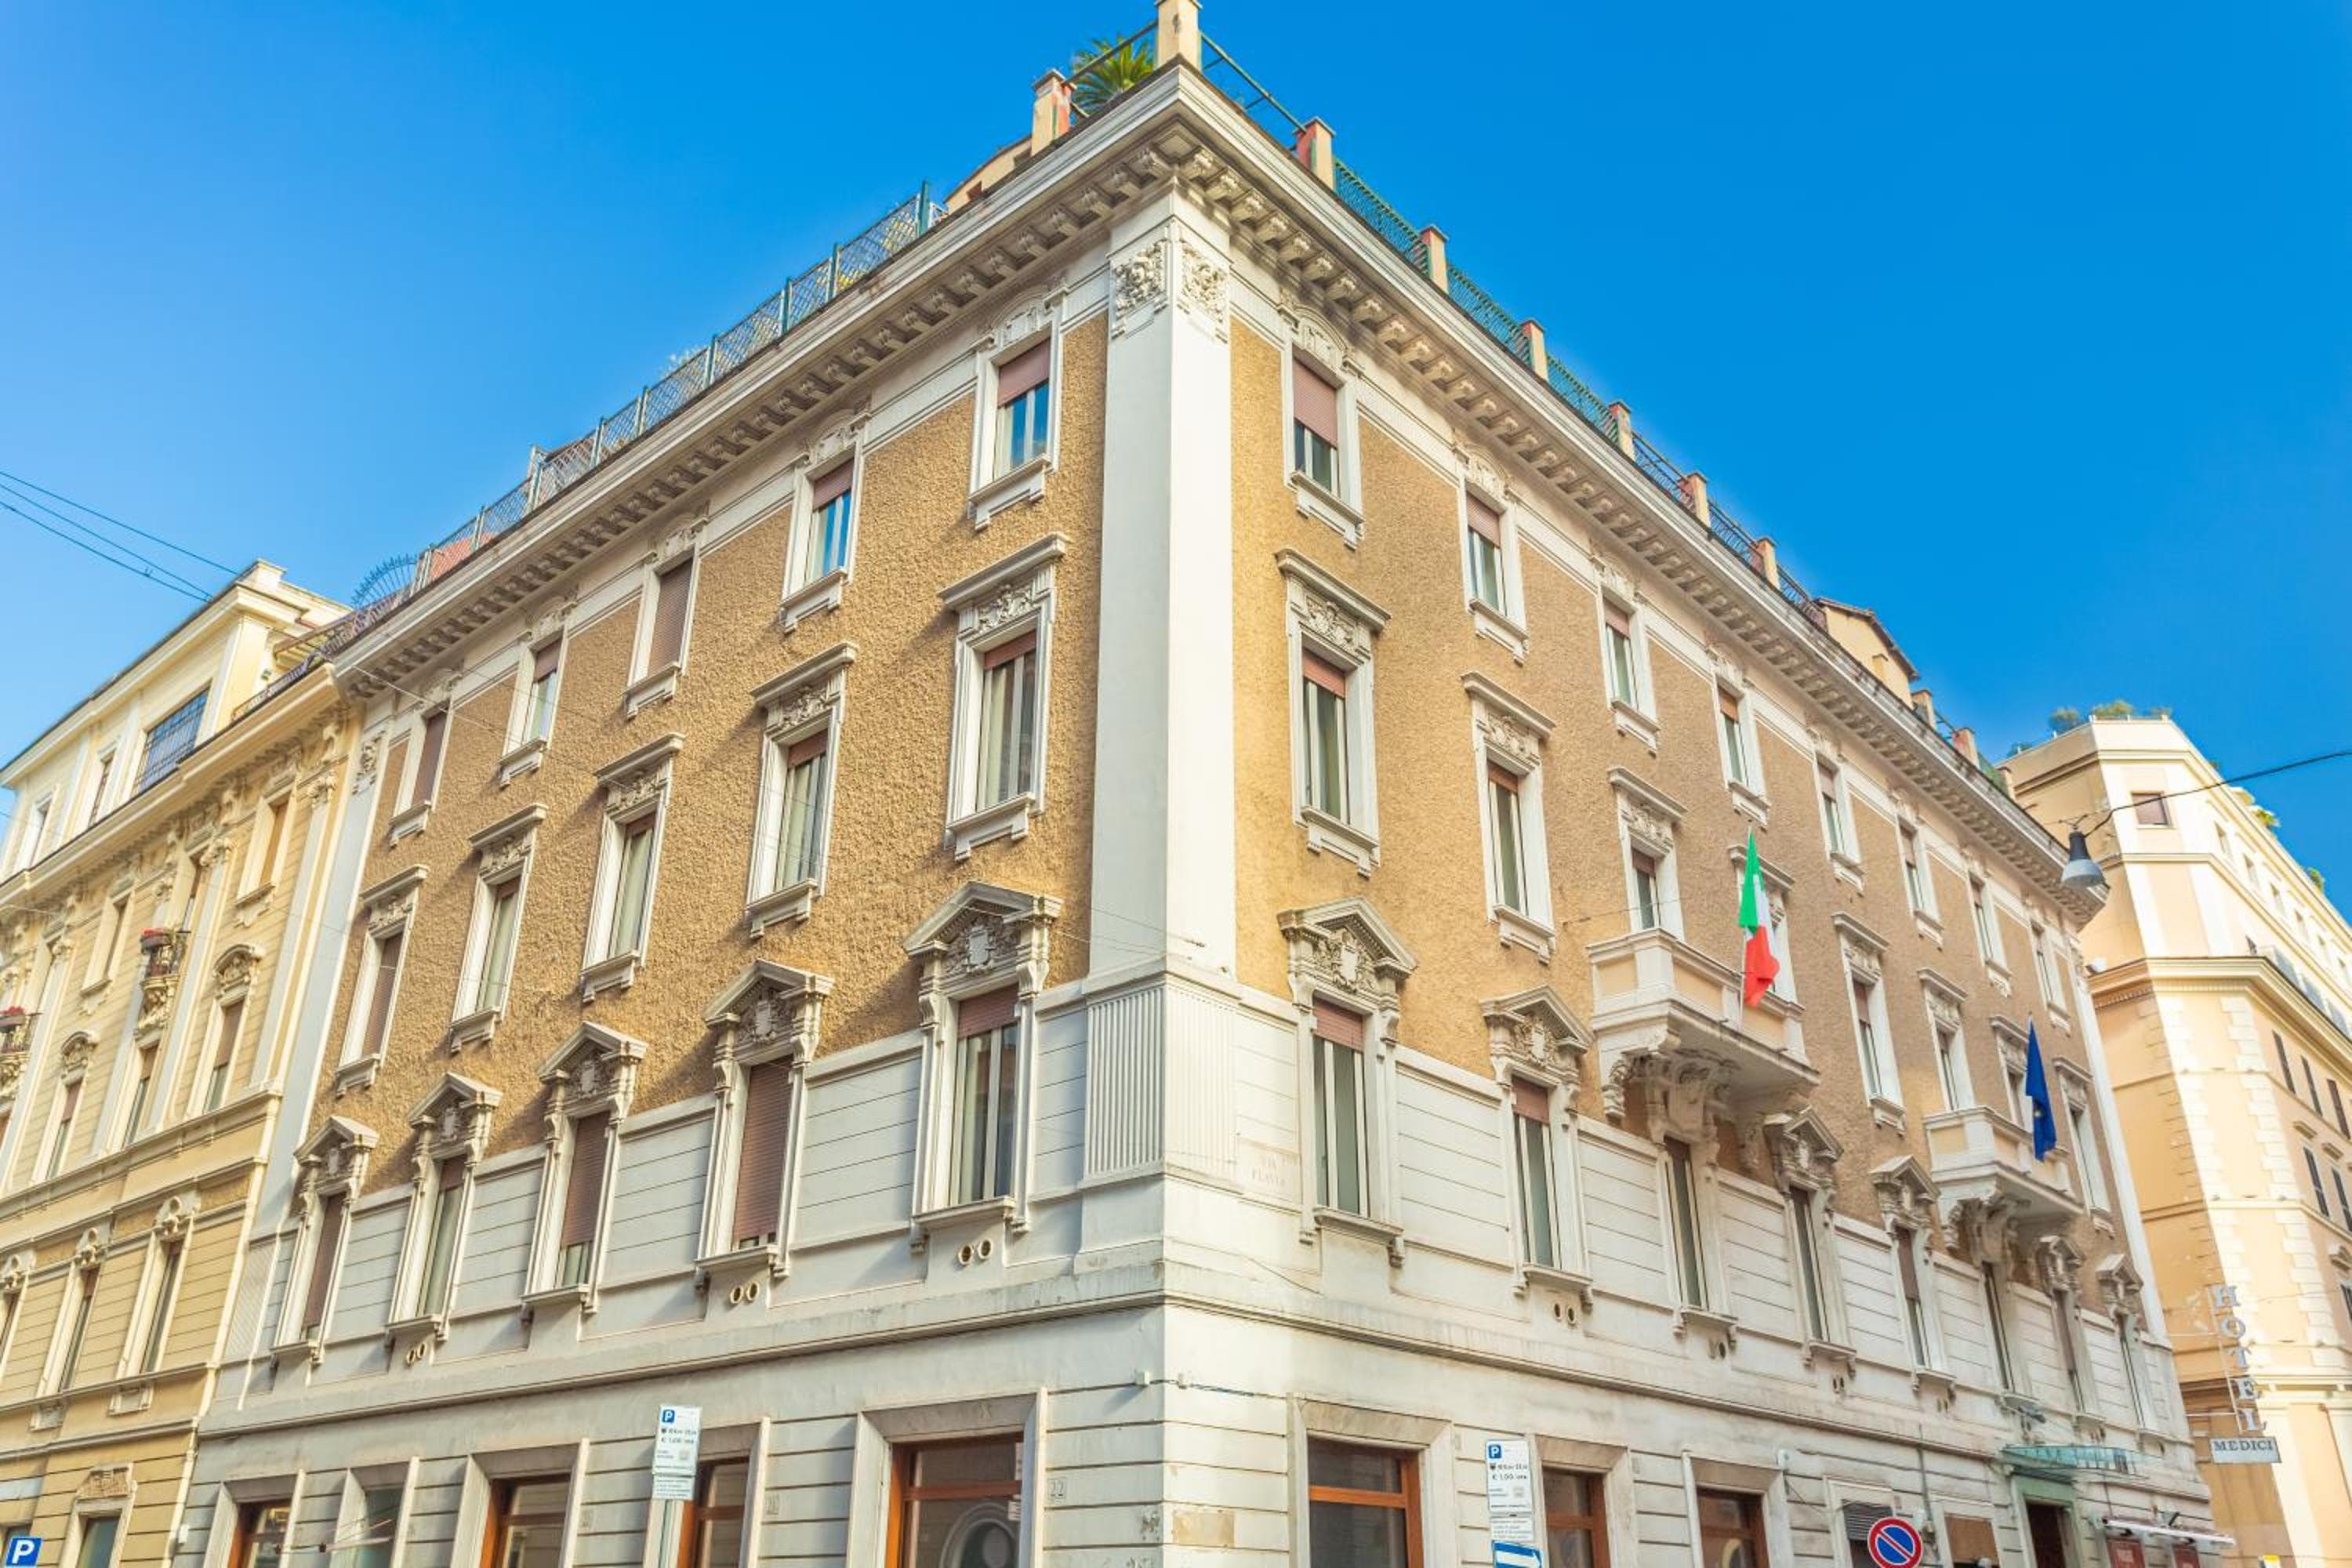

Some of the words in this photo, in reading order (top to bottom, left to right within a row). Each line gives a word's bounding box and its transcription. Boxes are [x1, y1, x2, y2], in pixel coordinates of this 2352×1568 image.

[2213, 1285, 2267, 1431] HOTEL
[1491, 1446, 1499, 1457] P
[2213, 1440, 2273, 1451] MEDICI
[13, 1540, 34, 1563] P
